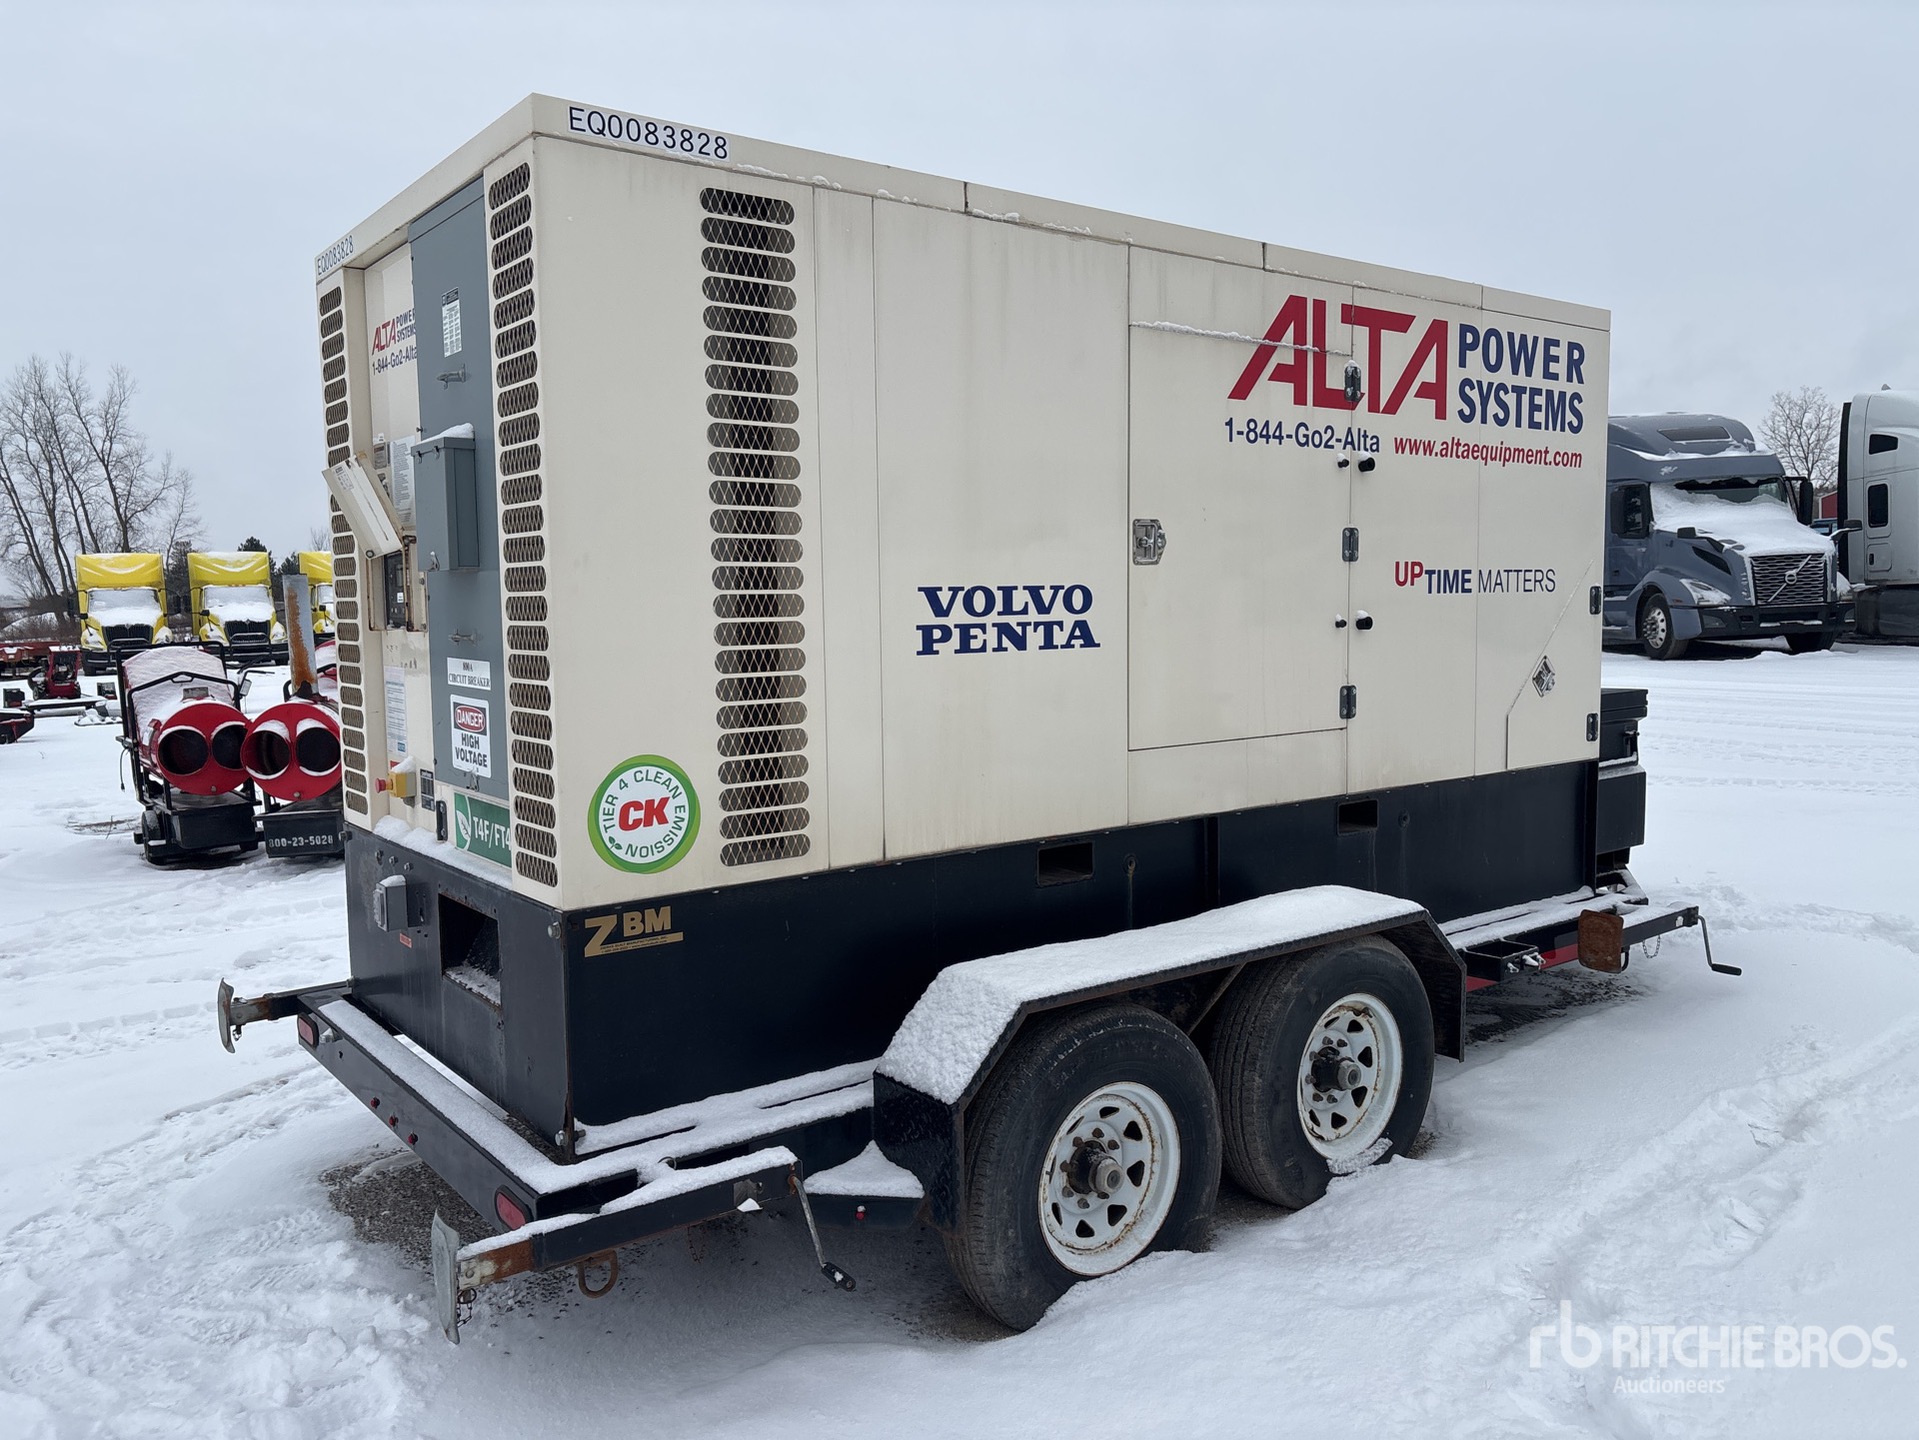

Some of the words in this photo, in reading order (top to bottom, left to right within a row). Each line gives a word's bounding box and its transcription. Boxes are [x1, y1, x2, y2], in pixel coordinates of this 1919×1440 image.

[568, 106, 728, 160] EQ0083828
[317, 234, 354, 276] EQ0083828
[371, 317, 397, 356] ALTA
[1227, 294, 1449, 421] ALTA
[1458, 322, 1586, 385] POWER
[1457, 377, 1585, 435] SYSTEMS
[1224, 416, 1381, 453] 1-844-Go2-Alta
[1393, 436, 1583, 469] www.altaequipment.com
[1478, 568, 1557, 594] MATTERS
[917, 584, 1094, 619] VOLVO
[915, 619, 1102, 656] PENTA
[449, 672, 467, 684] CIRCUIT
[468, 675, 490, 687] BREAKER
[456, 709, 484, 728] DANGER
[454, 746, 488, 768] VOLTAGE
[461, 732, 480, 750] HIGH
[618, 777, 630, 791] 4
[633, 769, 683, 800] CLEAN
[602, 793, 619, 834] TIER
[618, 796, 671, 832] CK
[625, 804, 686, 858] EMISSION
